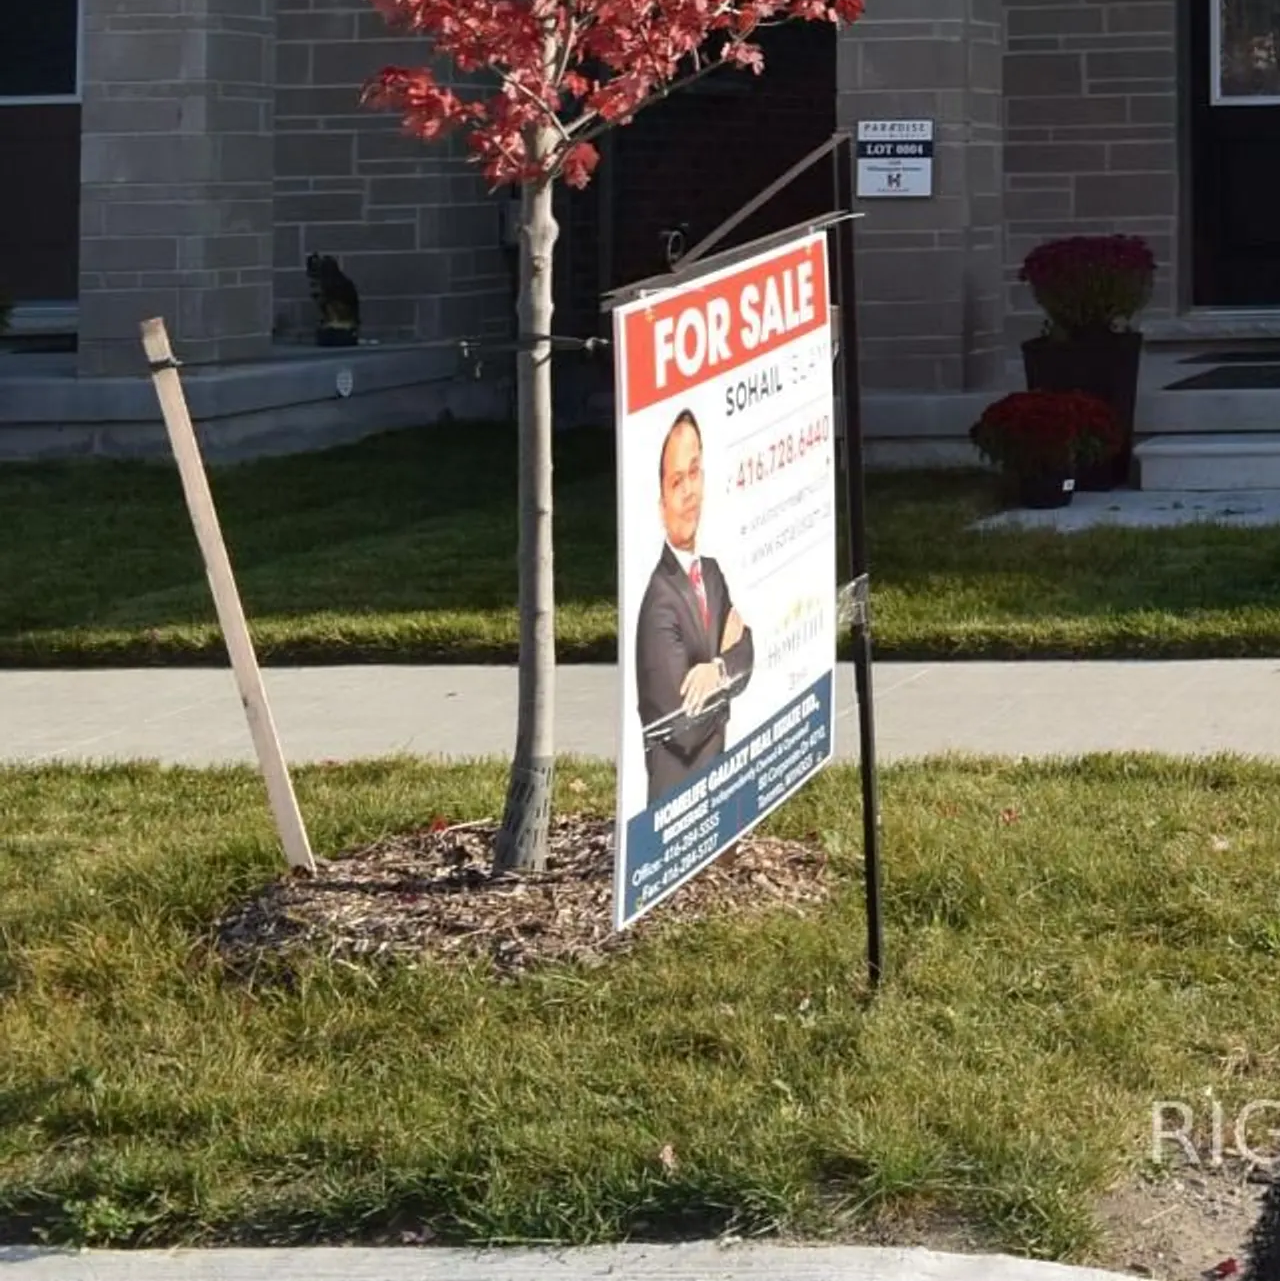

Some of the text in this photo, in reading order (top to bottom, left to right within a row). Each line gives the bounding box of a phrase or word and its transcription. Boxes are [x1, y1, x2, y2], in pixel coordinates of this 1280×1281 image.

[864, 123, 926, 132] PARADISE
[866, 144, 893, 155] LOT
[653, 260, 816, 390] FOR SALE
[726, 365, 783, 416] SOHAIL
[736, 415, 830, 490] 416.728.6440
[653, 777, 708, 832] HOMELIFE
[708, 745, 750, 792] GALAXY
[750, 727, 772, 761] REAL
